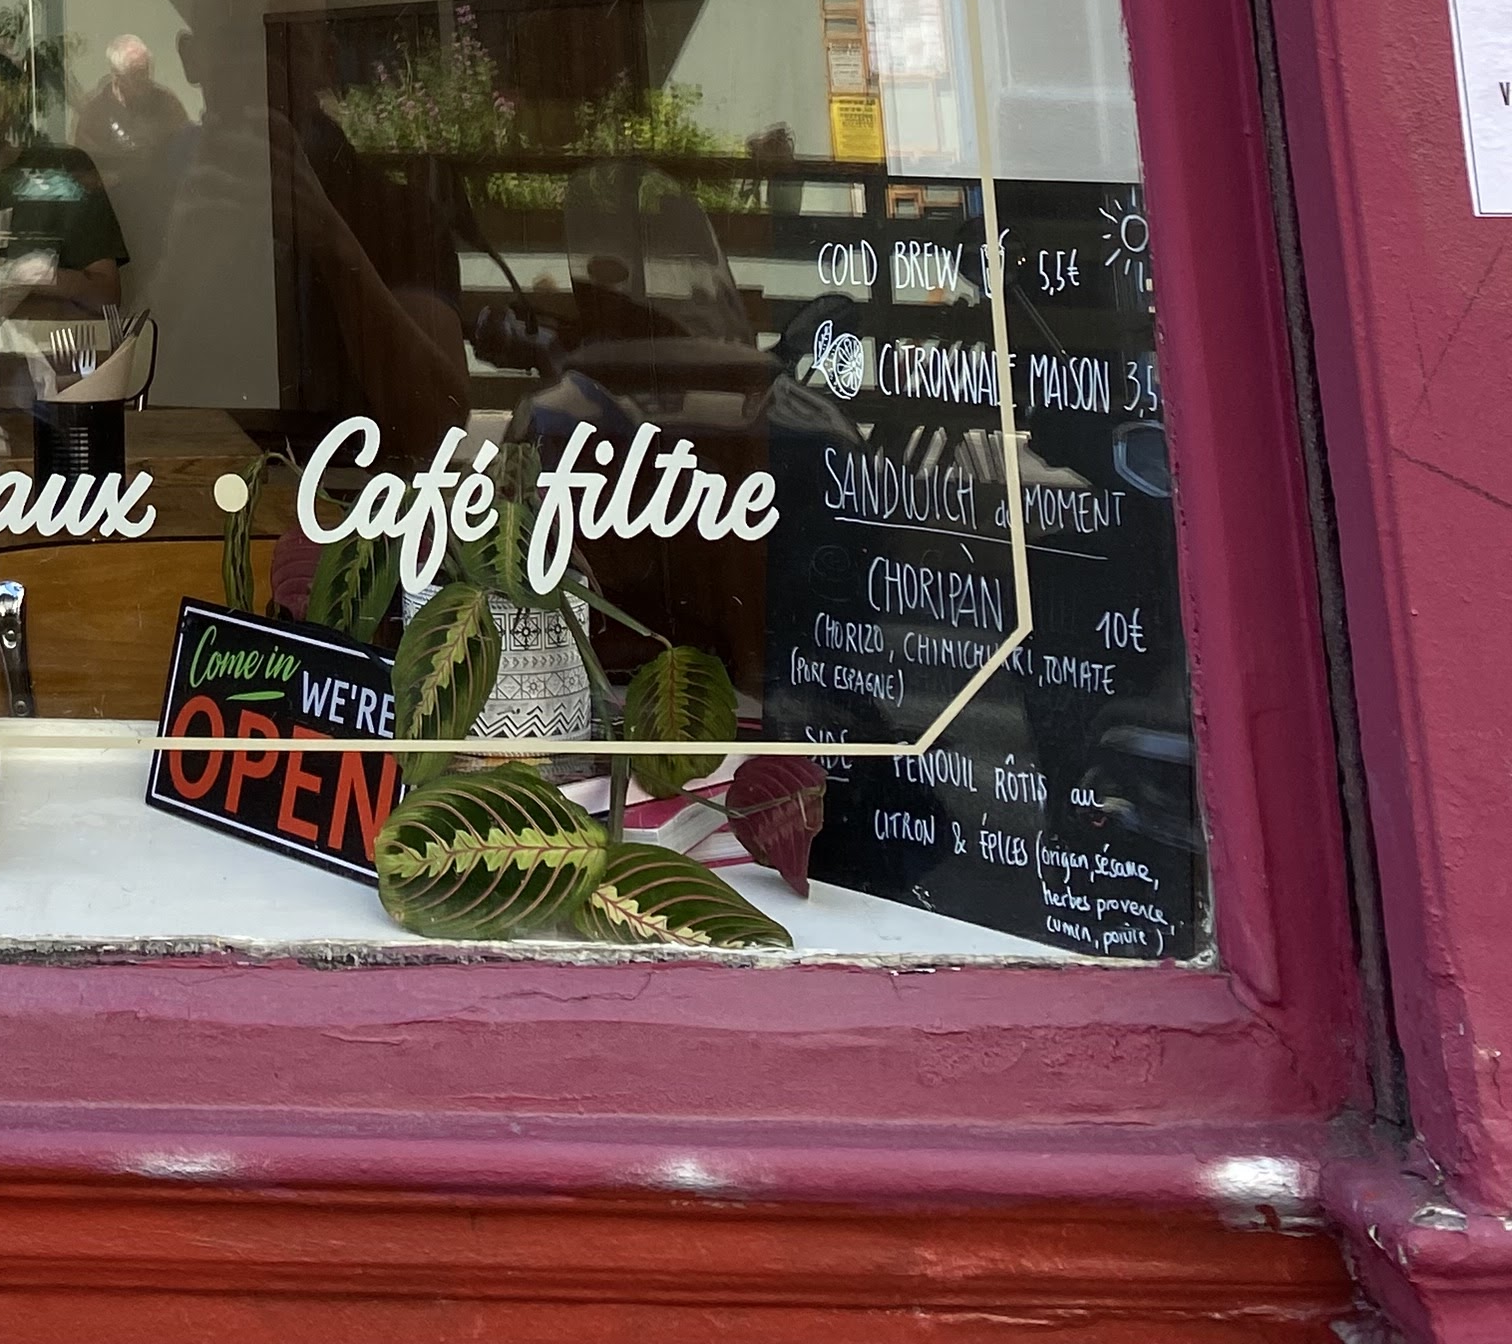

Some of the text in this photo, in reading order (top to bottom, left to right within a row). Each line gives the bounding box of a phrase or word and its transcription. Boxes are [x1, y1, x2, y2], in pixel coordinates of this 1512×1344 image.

[817, 239, 1080, 296] COLD BREW 5,5€
[1029, 354, 1110, 414] MAISON
[297, 416, 500, 594] Café
[526, 421, 780, 595] filtre
[824, 447, 977, 530] SANDWICH
[1025, 484, 1126, 534] MOMENT
[189, 625, 301, 689] Come in
[1096, 608, 1147, 653] 10€
[302, 670, 395, 739] WE'RE
[169, 694, 398, 862] OPEN
[874, 809, 935, 845] CITRON
[952, 823, 967, 855] &
